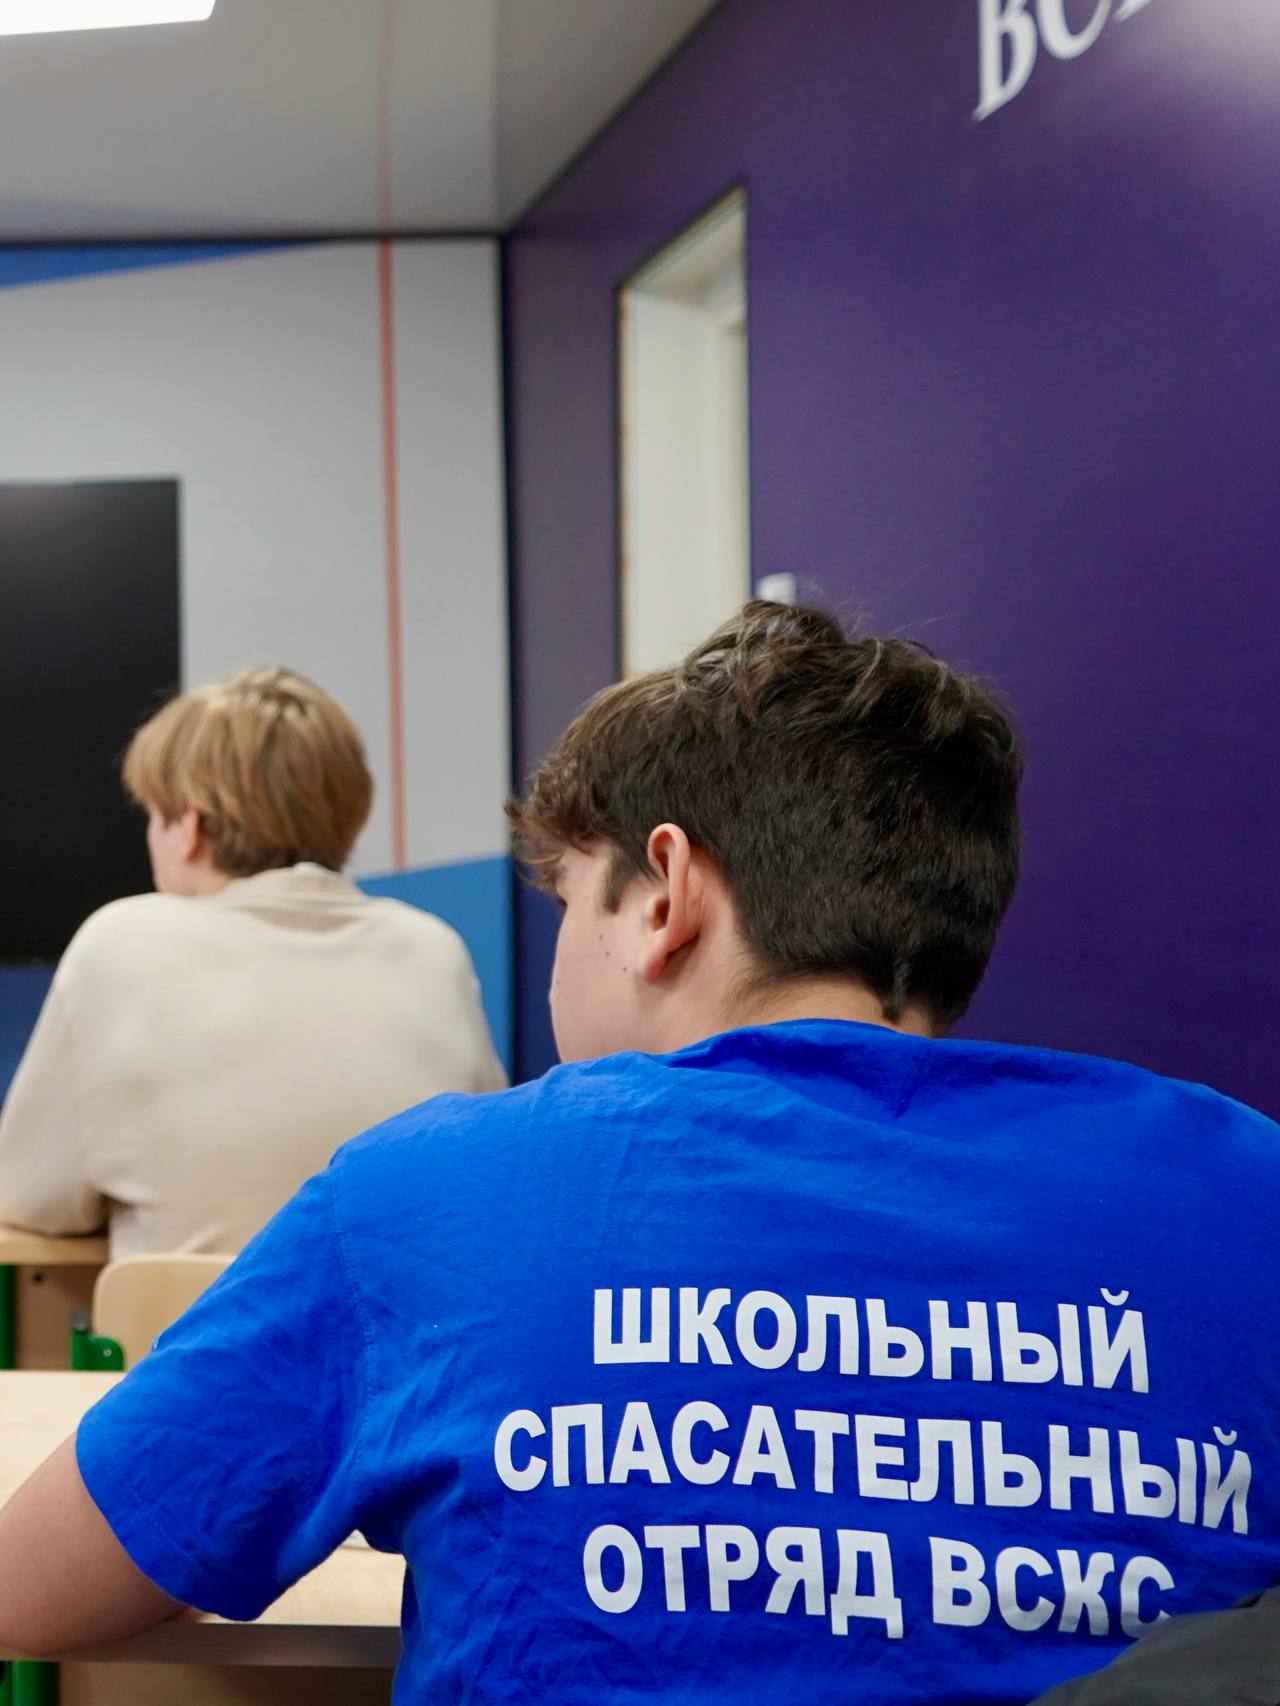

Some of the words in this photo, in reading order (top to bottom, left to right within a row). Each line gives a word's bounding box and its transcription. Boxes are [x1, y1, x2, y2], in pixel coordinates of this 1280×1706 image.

[593, 1287, 1149, 1393] ШКОЛЬНЫЙ
[494, 1400, 1252, 1535] СПАСАТЕЛЬНЫЙ
[583, 1524, 904, 1639] ОТРЯД
[928, 1536, 1176, 1639] ВСКС
